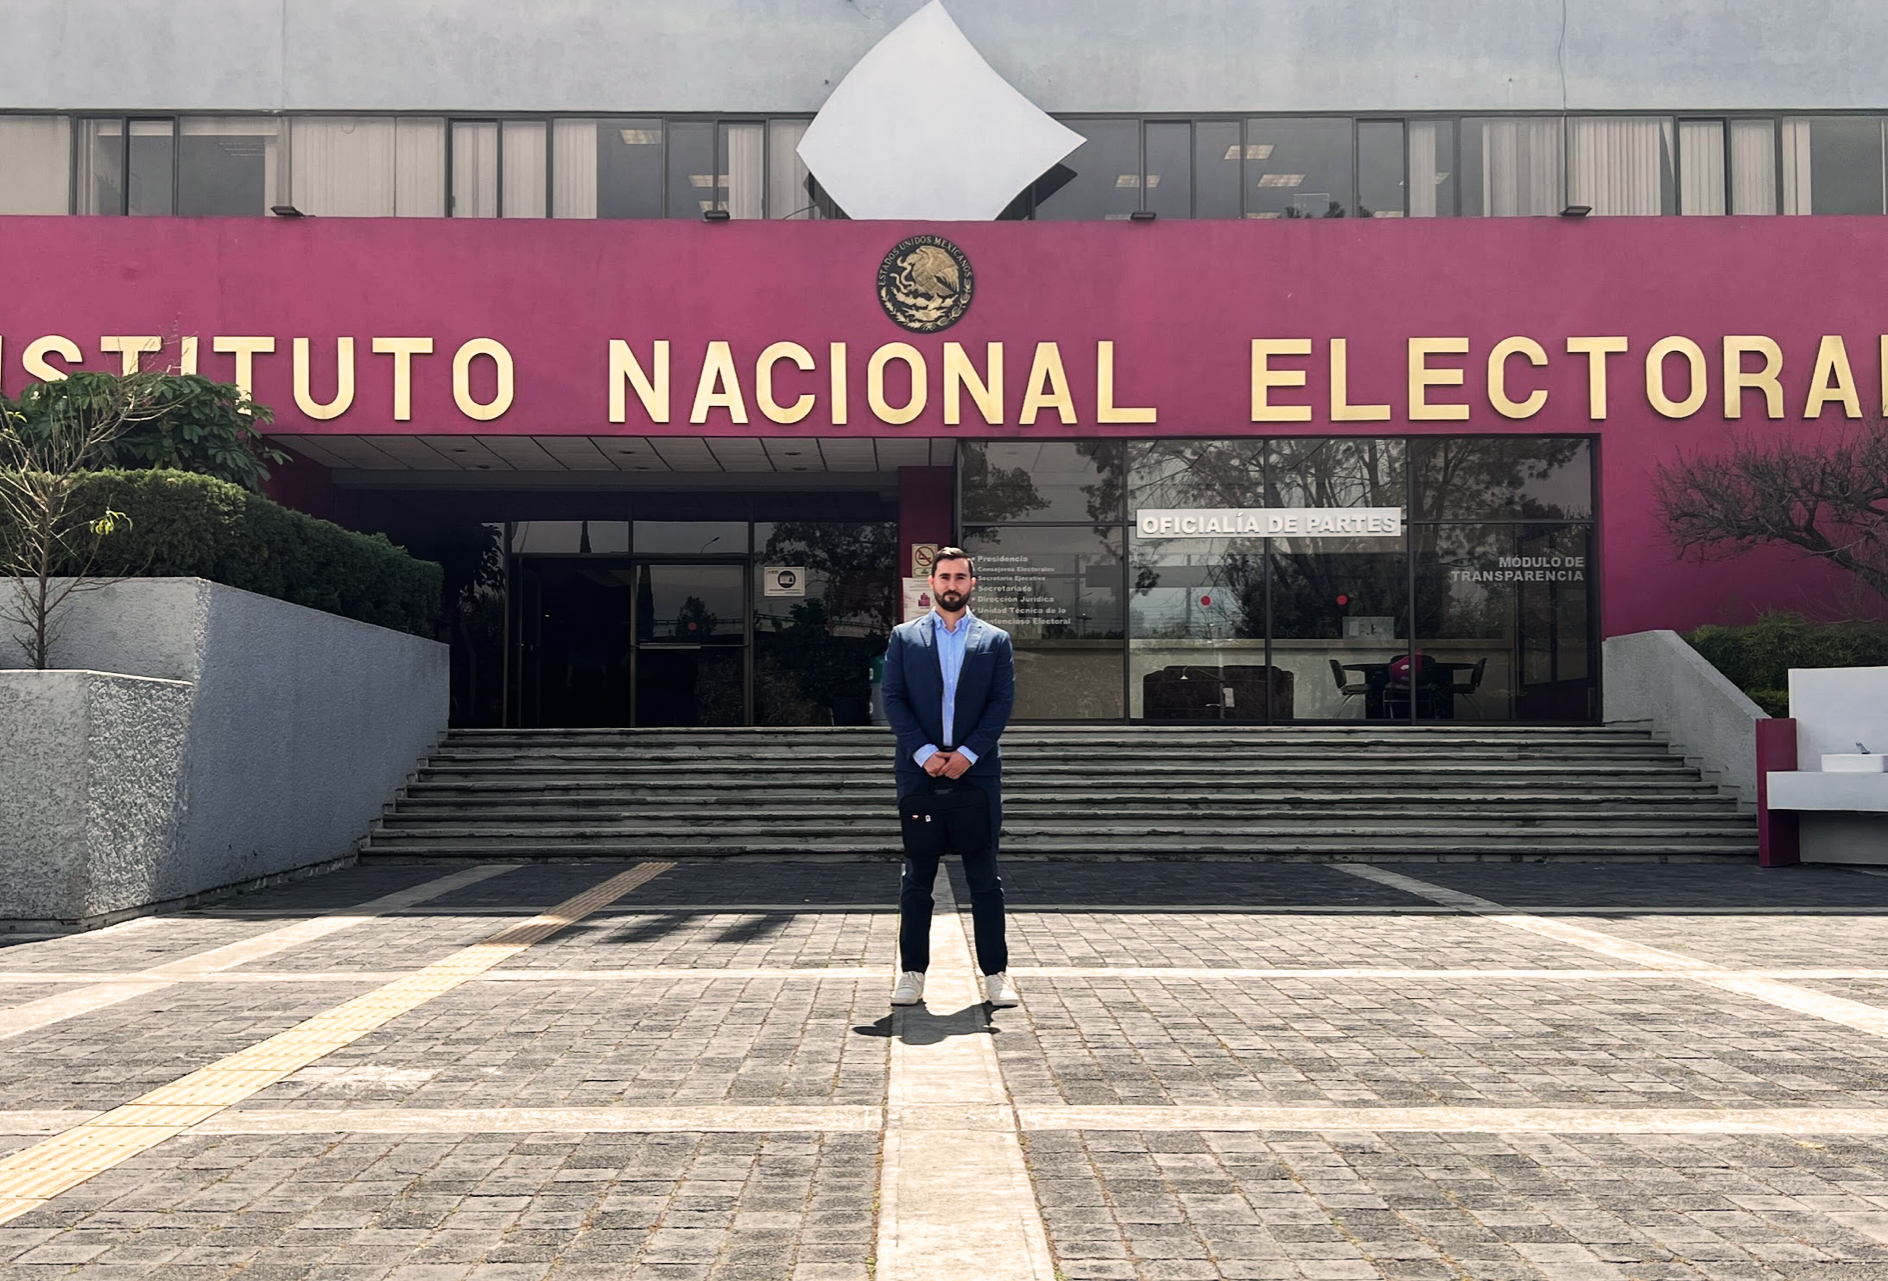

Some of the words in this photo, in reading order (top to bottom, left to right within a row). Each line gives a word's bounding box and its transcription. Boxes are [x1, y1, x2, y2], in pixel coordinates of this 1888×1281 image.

[878, 248, 899, 286] ESTADOS
[899, 236, 932, 251] UNIDOS
[933, 237, 973, 278] MEXICANOS
[608, 338, 1158, 426] NACIONAL
[1250, 334, 1888, 423] ELECTORA
[1142, 512, 1260, 535] OFICIALÍA
[1267, 515, 1298, 534] DE
[1306, 514, 1398, 534] PARTES
[1499, 554, 1561, 568] MÓDULO
[1564, 556, 1585, 568] DE
[1450, 570, 1584, 581] TRANSPARENCIA
